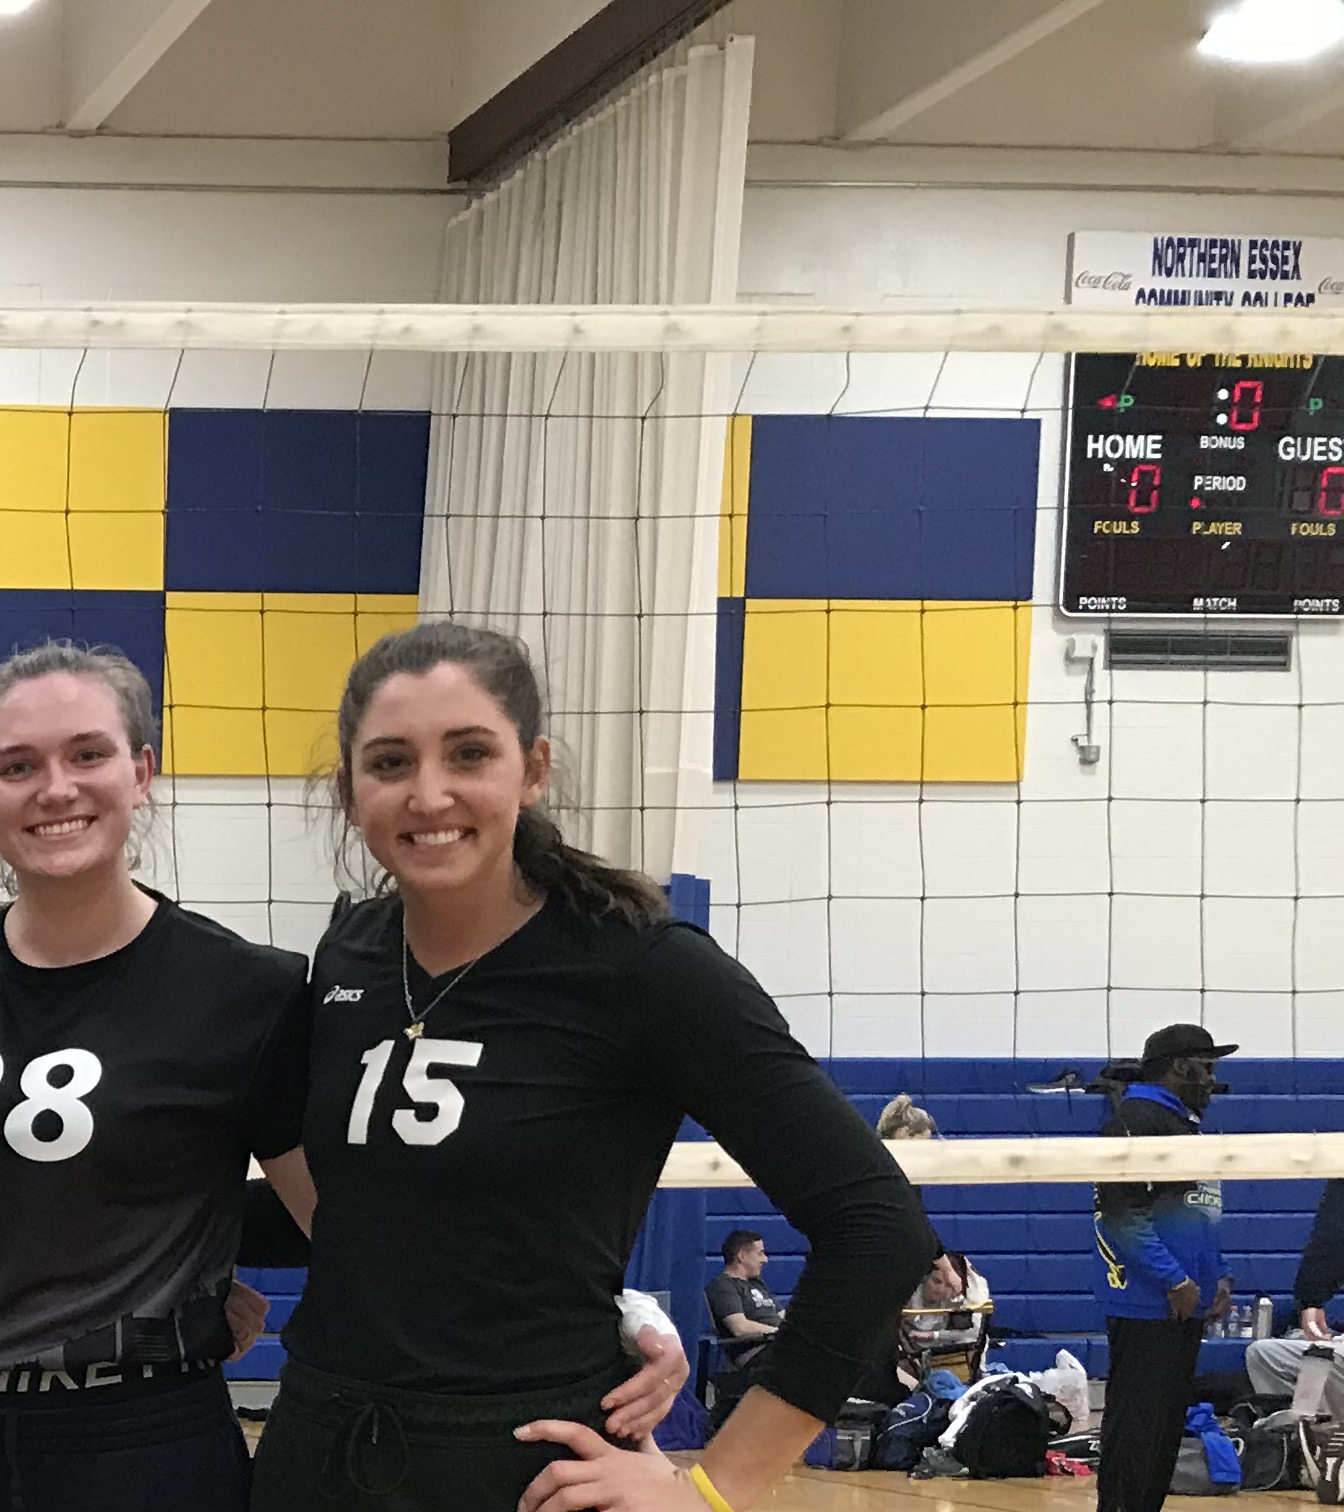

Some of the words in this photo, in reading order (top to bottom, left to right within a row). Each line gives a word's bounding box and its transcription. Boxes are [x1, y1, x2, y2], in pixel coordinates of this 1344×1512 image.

[1152, 236, 1242, 279] NORTHERN
[1247, 238, 1303, 281] ESSEX
[1086, 434, 1162, 459] HOME
[1199, 435, 1246, 450] BONUS
[1278, 436, 1344, 461] GUES
[1128, 464, 1161, 514] 0
[1193, 475, 1246, 491] PERIOD
[1093, 520, 1141, 535] FOULS
[1192, 522, 1243, 536] PLAYER
[1291, 522, 1337, 537] FOULS
[1078, 597, 1127, 611] POINTS
[1192, 598, 1238, 611] MATCH
[1293, 599, 1341, 612] POINTS
[347, 1037, 485, 1146] 15
